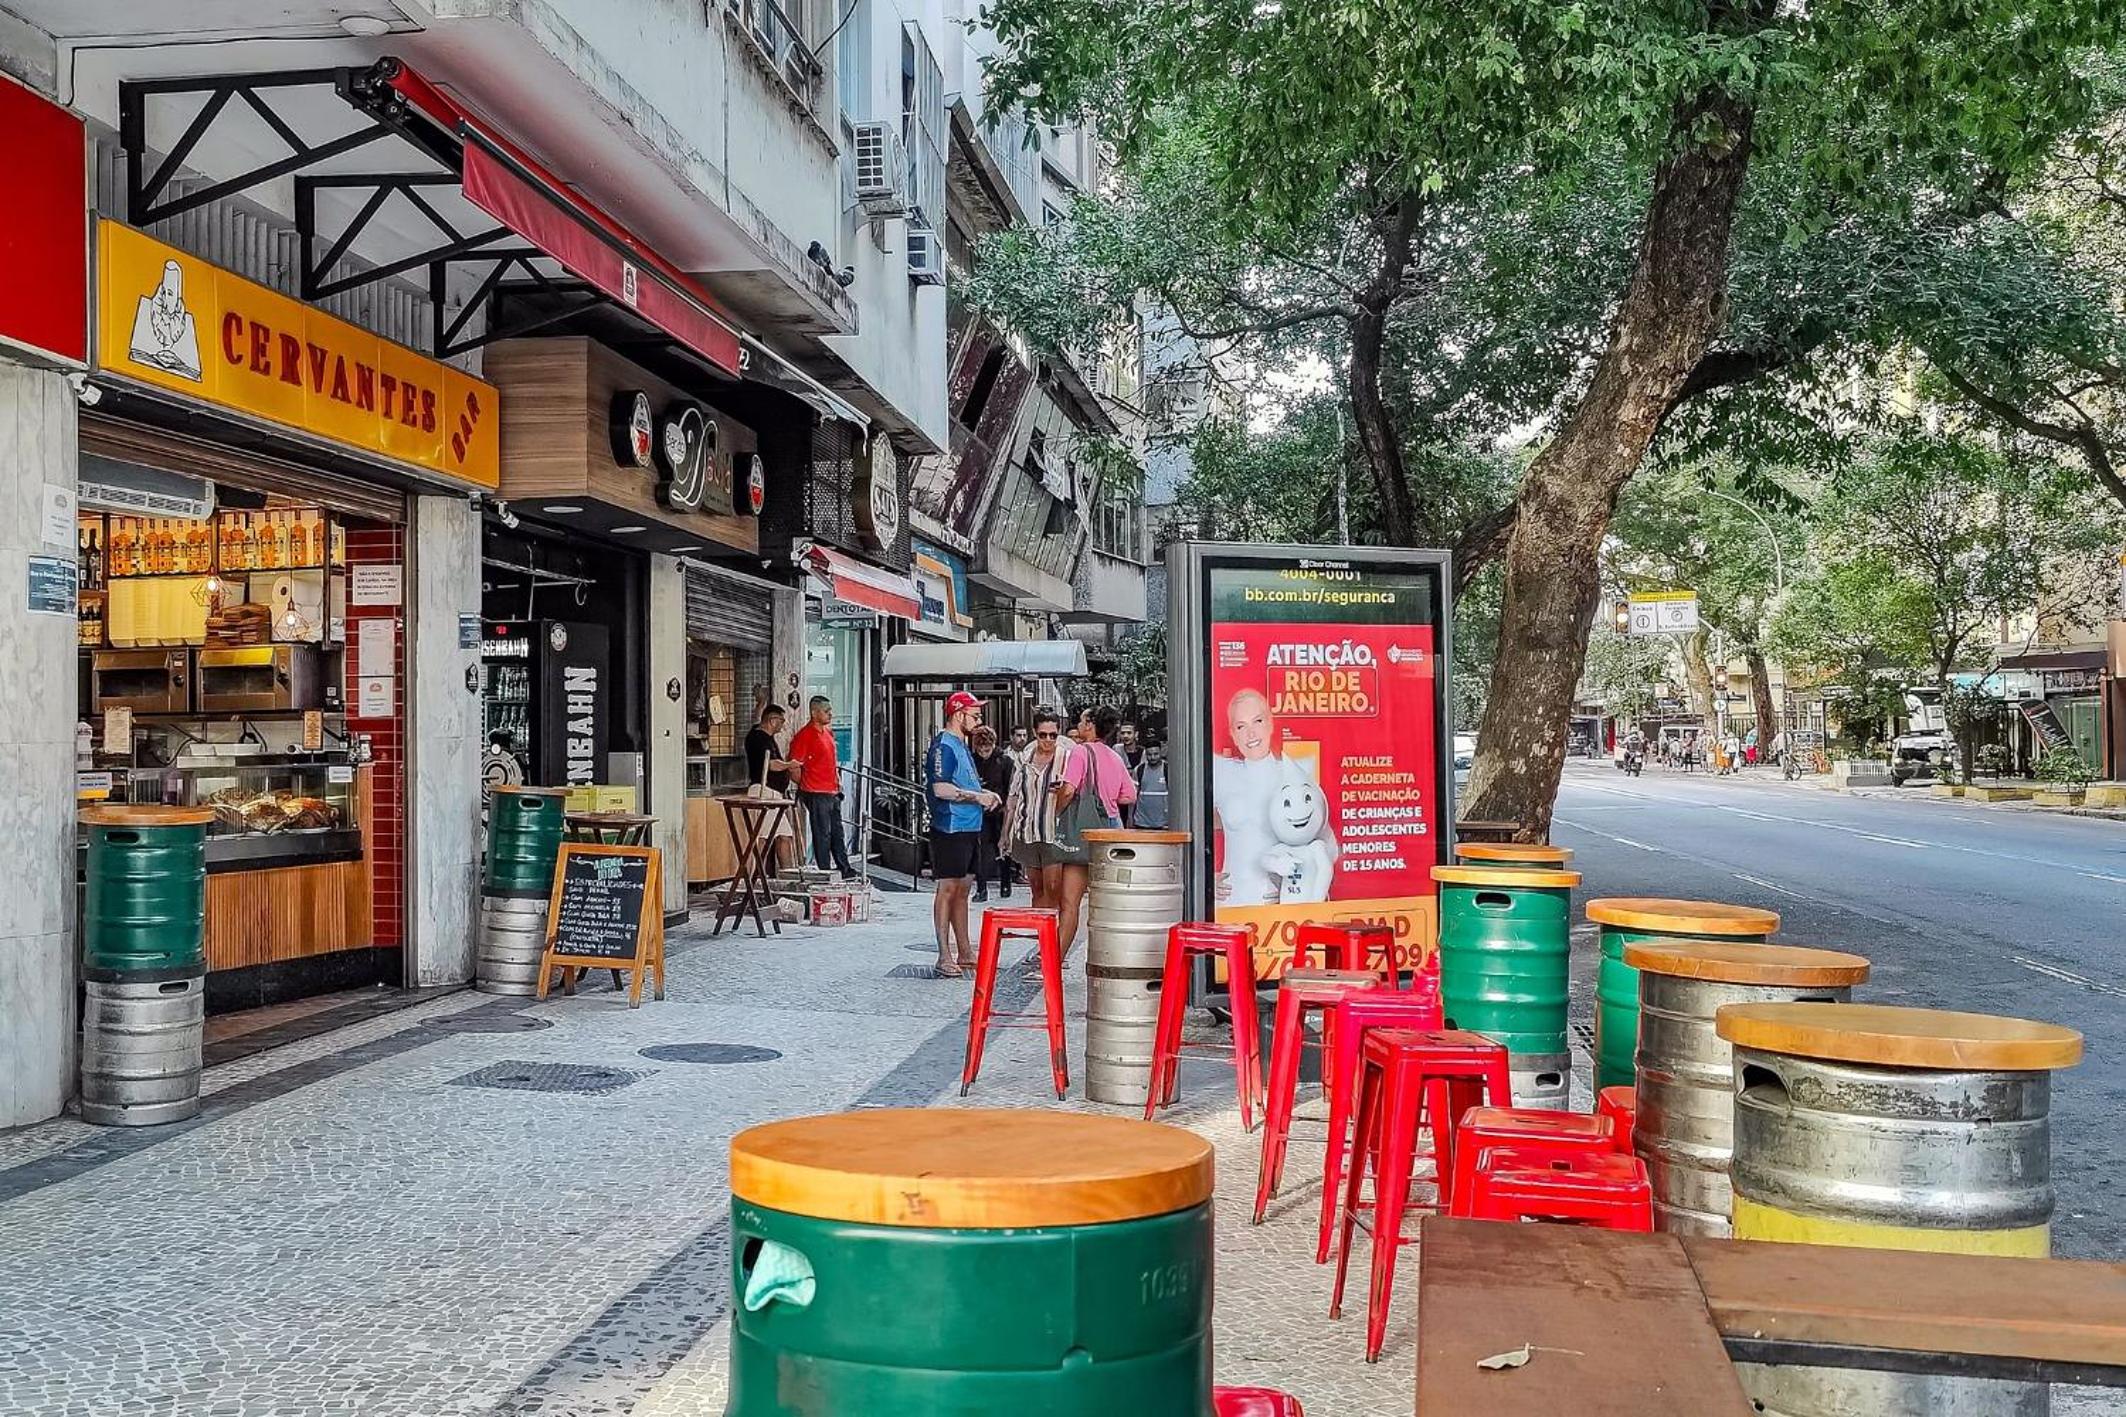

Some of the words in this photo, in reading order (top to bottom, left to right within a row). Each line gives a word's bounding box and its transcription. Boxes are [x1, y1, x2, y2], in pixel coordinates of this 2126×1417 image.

[221, 311, 437, 434] CERVANTES
[451, 390, 482, 465] BAR
[1266, 639, 1377, 671] ATENÇÃO,
[1285, 672, 1326, 691] RIO
[1331, 671, 1360, 691] DE
[1271, 692, 1375, 713] JANEIRO.
[565, 666, 598, 786] NBAHN
[1341, 756, 1393, 768] ATUALIZE
[1341, 774, 1349, 785] A
[1350, 773, 1415, 784] CADERNETA
[1341, 791, 1358, 802] DE
[1358, 789, 1420, 803] VACINAÇÃO
[1342, 808, 1357, 820] DE
[1358, 807, 1414, 821] CRIANÇAS
[1414, 806, 1422, 817] E
[1342, 823, 1427, 837] ADOLESCENTES
[1342, 842, 1396, 854] MENORES
[1343, 859, 1359, 871] DE
[1359, 859, 1373, 870] 15
[1373, 858, 1407, 870] ANOS.
[1394, 915, 1411, 938] D
